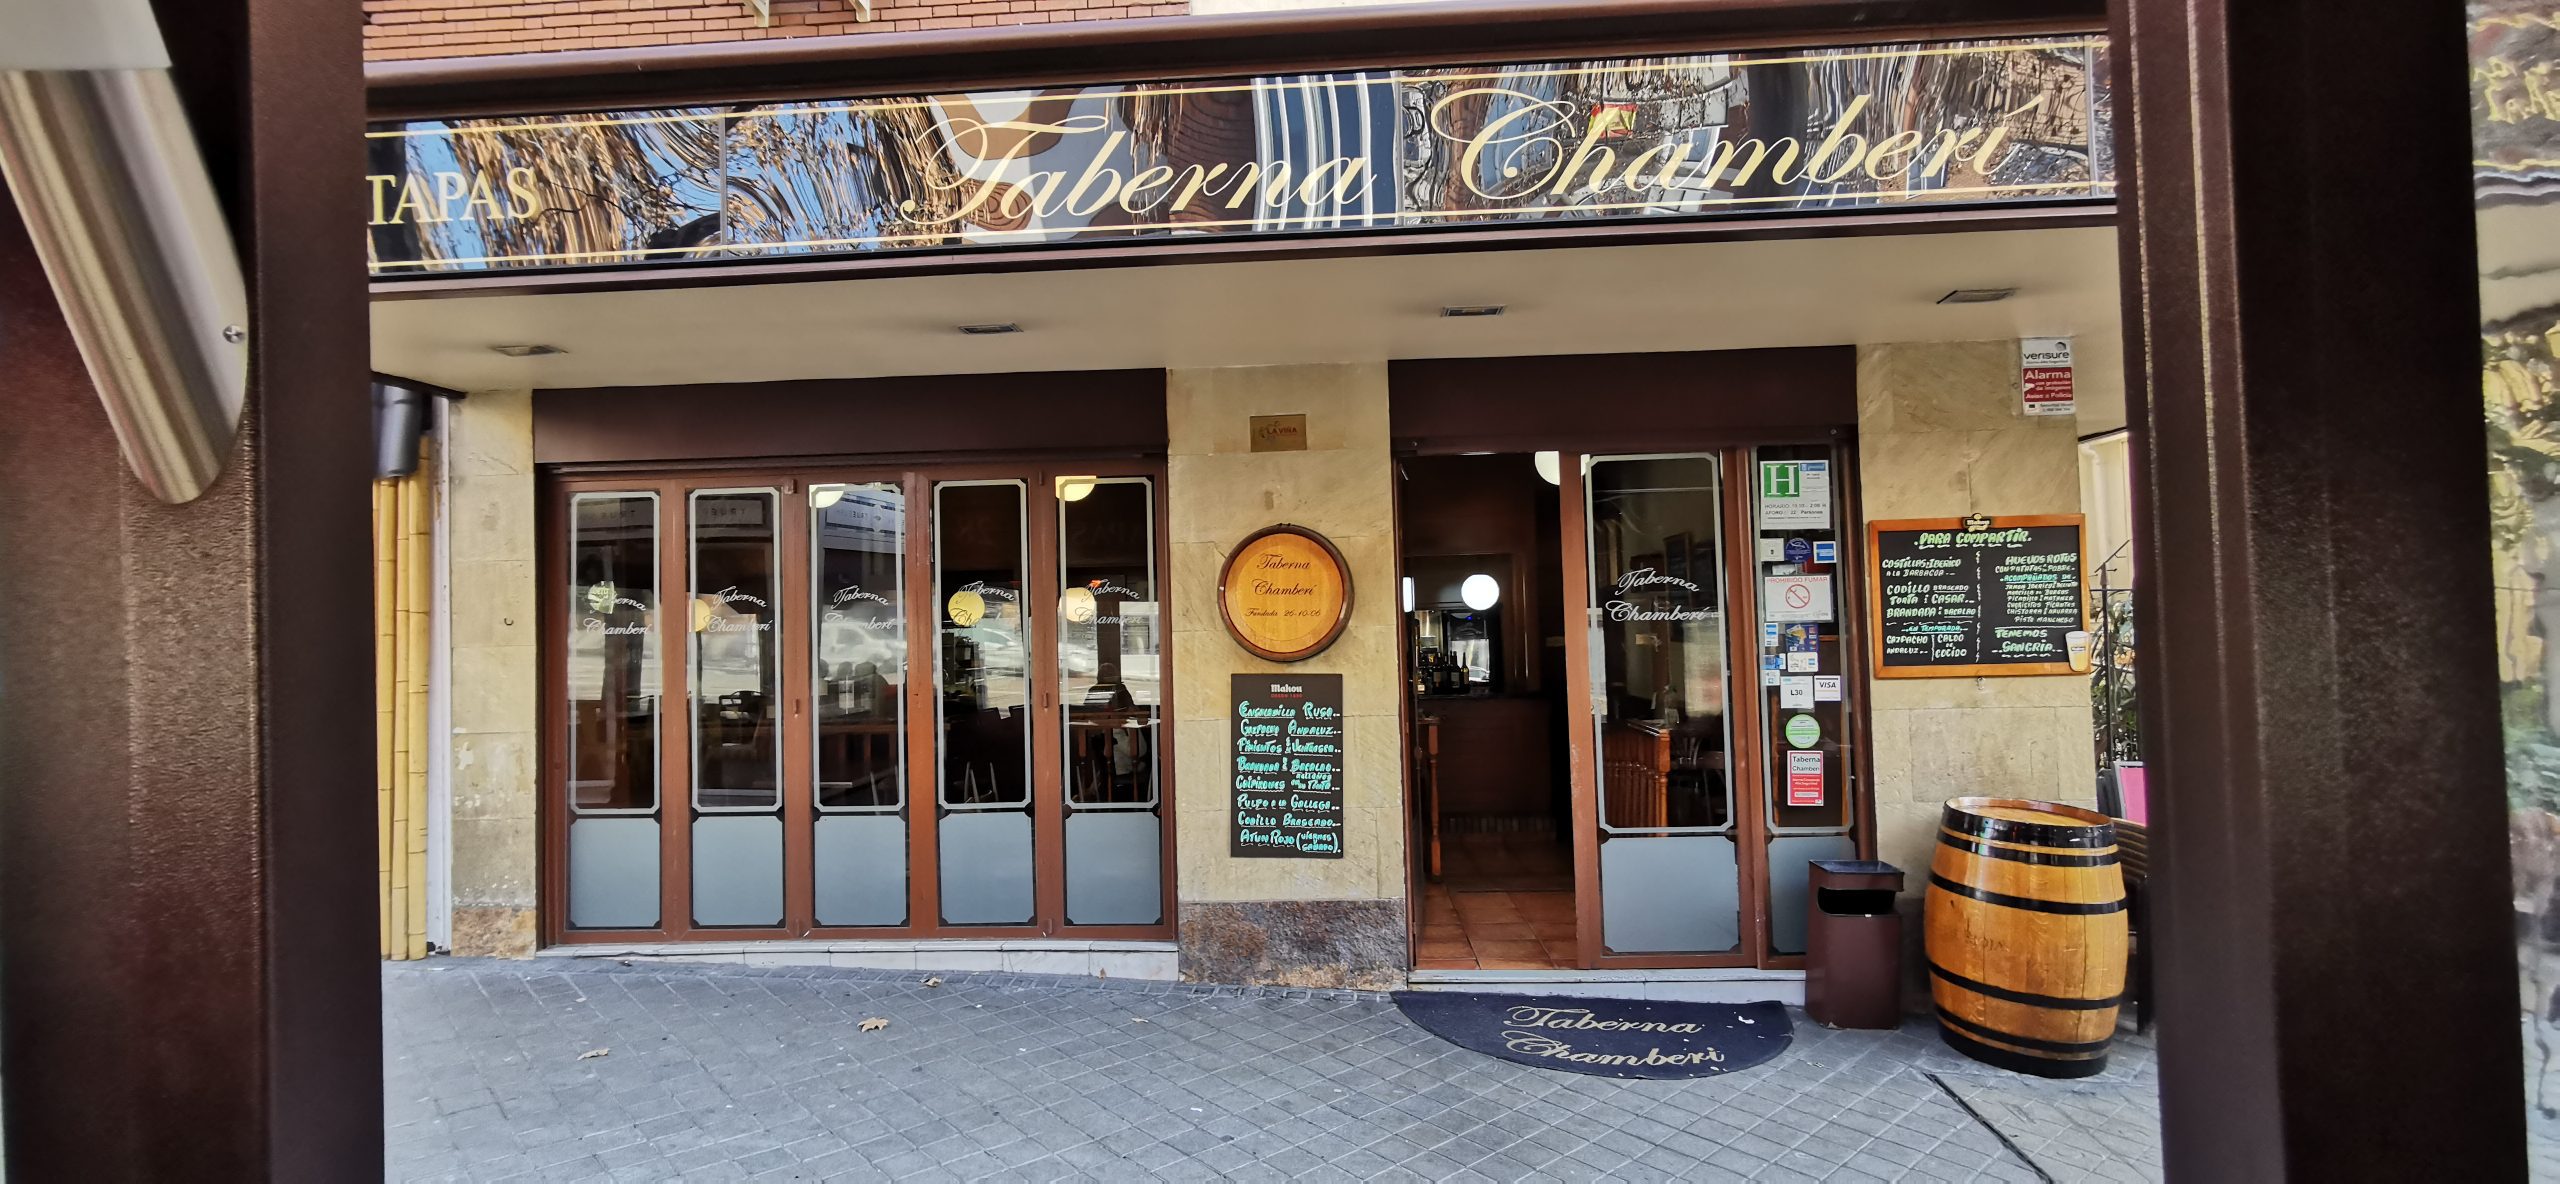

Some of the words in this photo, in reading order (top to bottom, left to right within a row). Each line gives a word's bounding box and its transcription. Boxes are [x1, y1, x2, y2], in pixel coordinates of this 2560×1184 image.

[900, 115, 1376, 225] Taberna
[1431, 89, 2044, 199] Chamberí
[365, 166, 538, 226] TAPAS
[2024, 351, 2069, 360] verisure
[2024, 369, 2071, 380] Alarma
[1766, 464, 1798, 495] H
[1919, 532, 1952, 545] PARA
[1256, 553, 1311, 570] Taberna
[2005, 555, 2046, 566] HUEVOS
[2046, 552, 2078, 564] ROTOS
[1903, 569, 1944, 577] BARBACOA
[1251, 578, 1318, 596] Chamberí
[1614, 567, 1700, 596] Taberna
[711, 585, 768, 610] Taberna
[831, 584, 889, 610] Taberna
[1605, 600, 1711, 622] Chamberí
[1937, 634, 1965, 643] CALDO
[1994, 629, 2048, 638] TENEMOS
[1934, 646, 1967, 659] COCIDO
[1270, 683, 1303, 693] Mahou
[1819, 681, 1837, 689] VISA
[1503, 1005, 1703, 1034] Taberna
